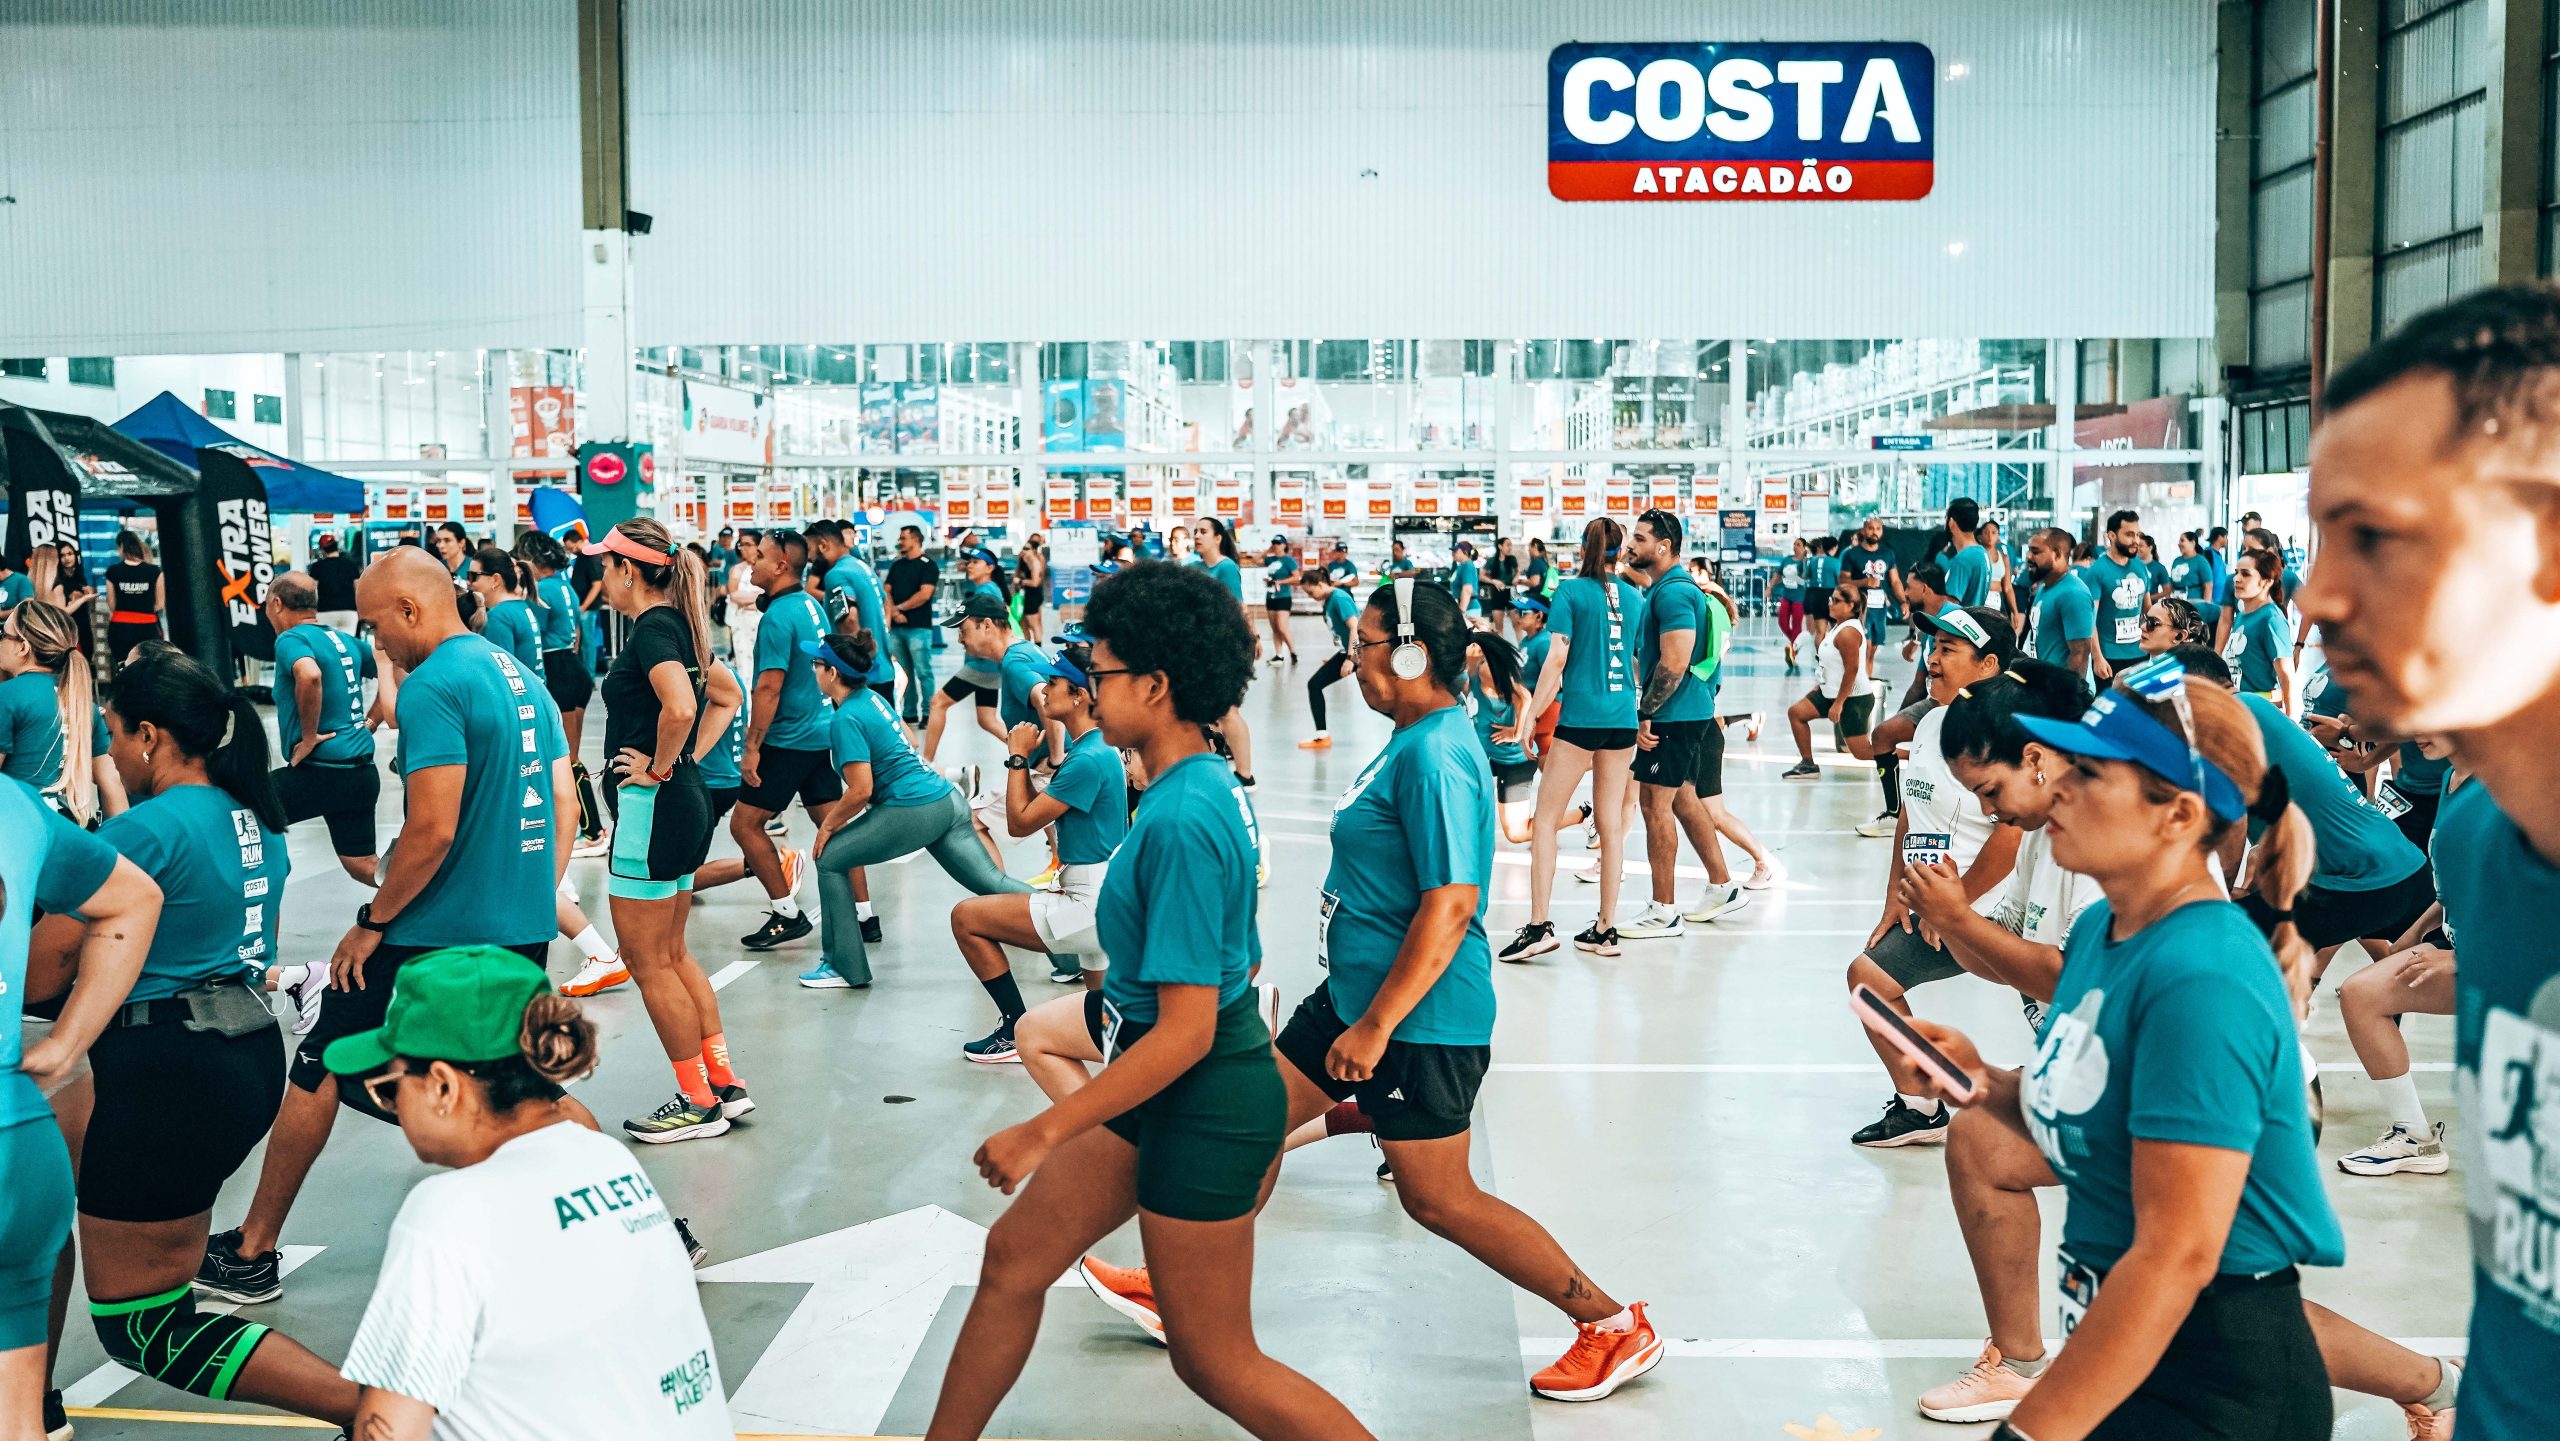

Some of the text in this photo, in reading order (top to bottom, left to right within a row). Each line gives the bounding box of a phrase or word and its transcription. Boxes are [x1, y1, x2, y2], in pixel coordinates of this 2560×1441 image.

[1563, 56, 1922, 144] COSTA
[1633, 158, 1853, 193] ATACADÃO
[217, 499, 260, 628] EXTRA
[246, 498, 274, 604] POWER
[241, 844, 263, 864] RUN
[245, 880, 267, 892] COSTA
[2494, 1194, 2560, 1301] RU
